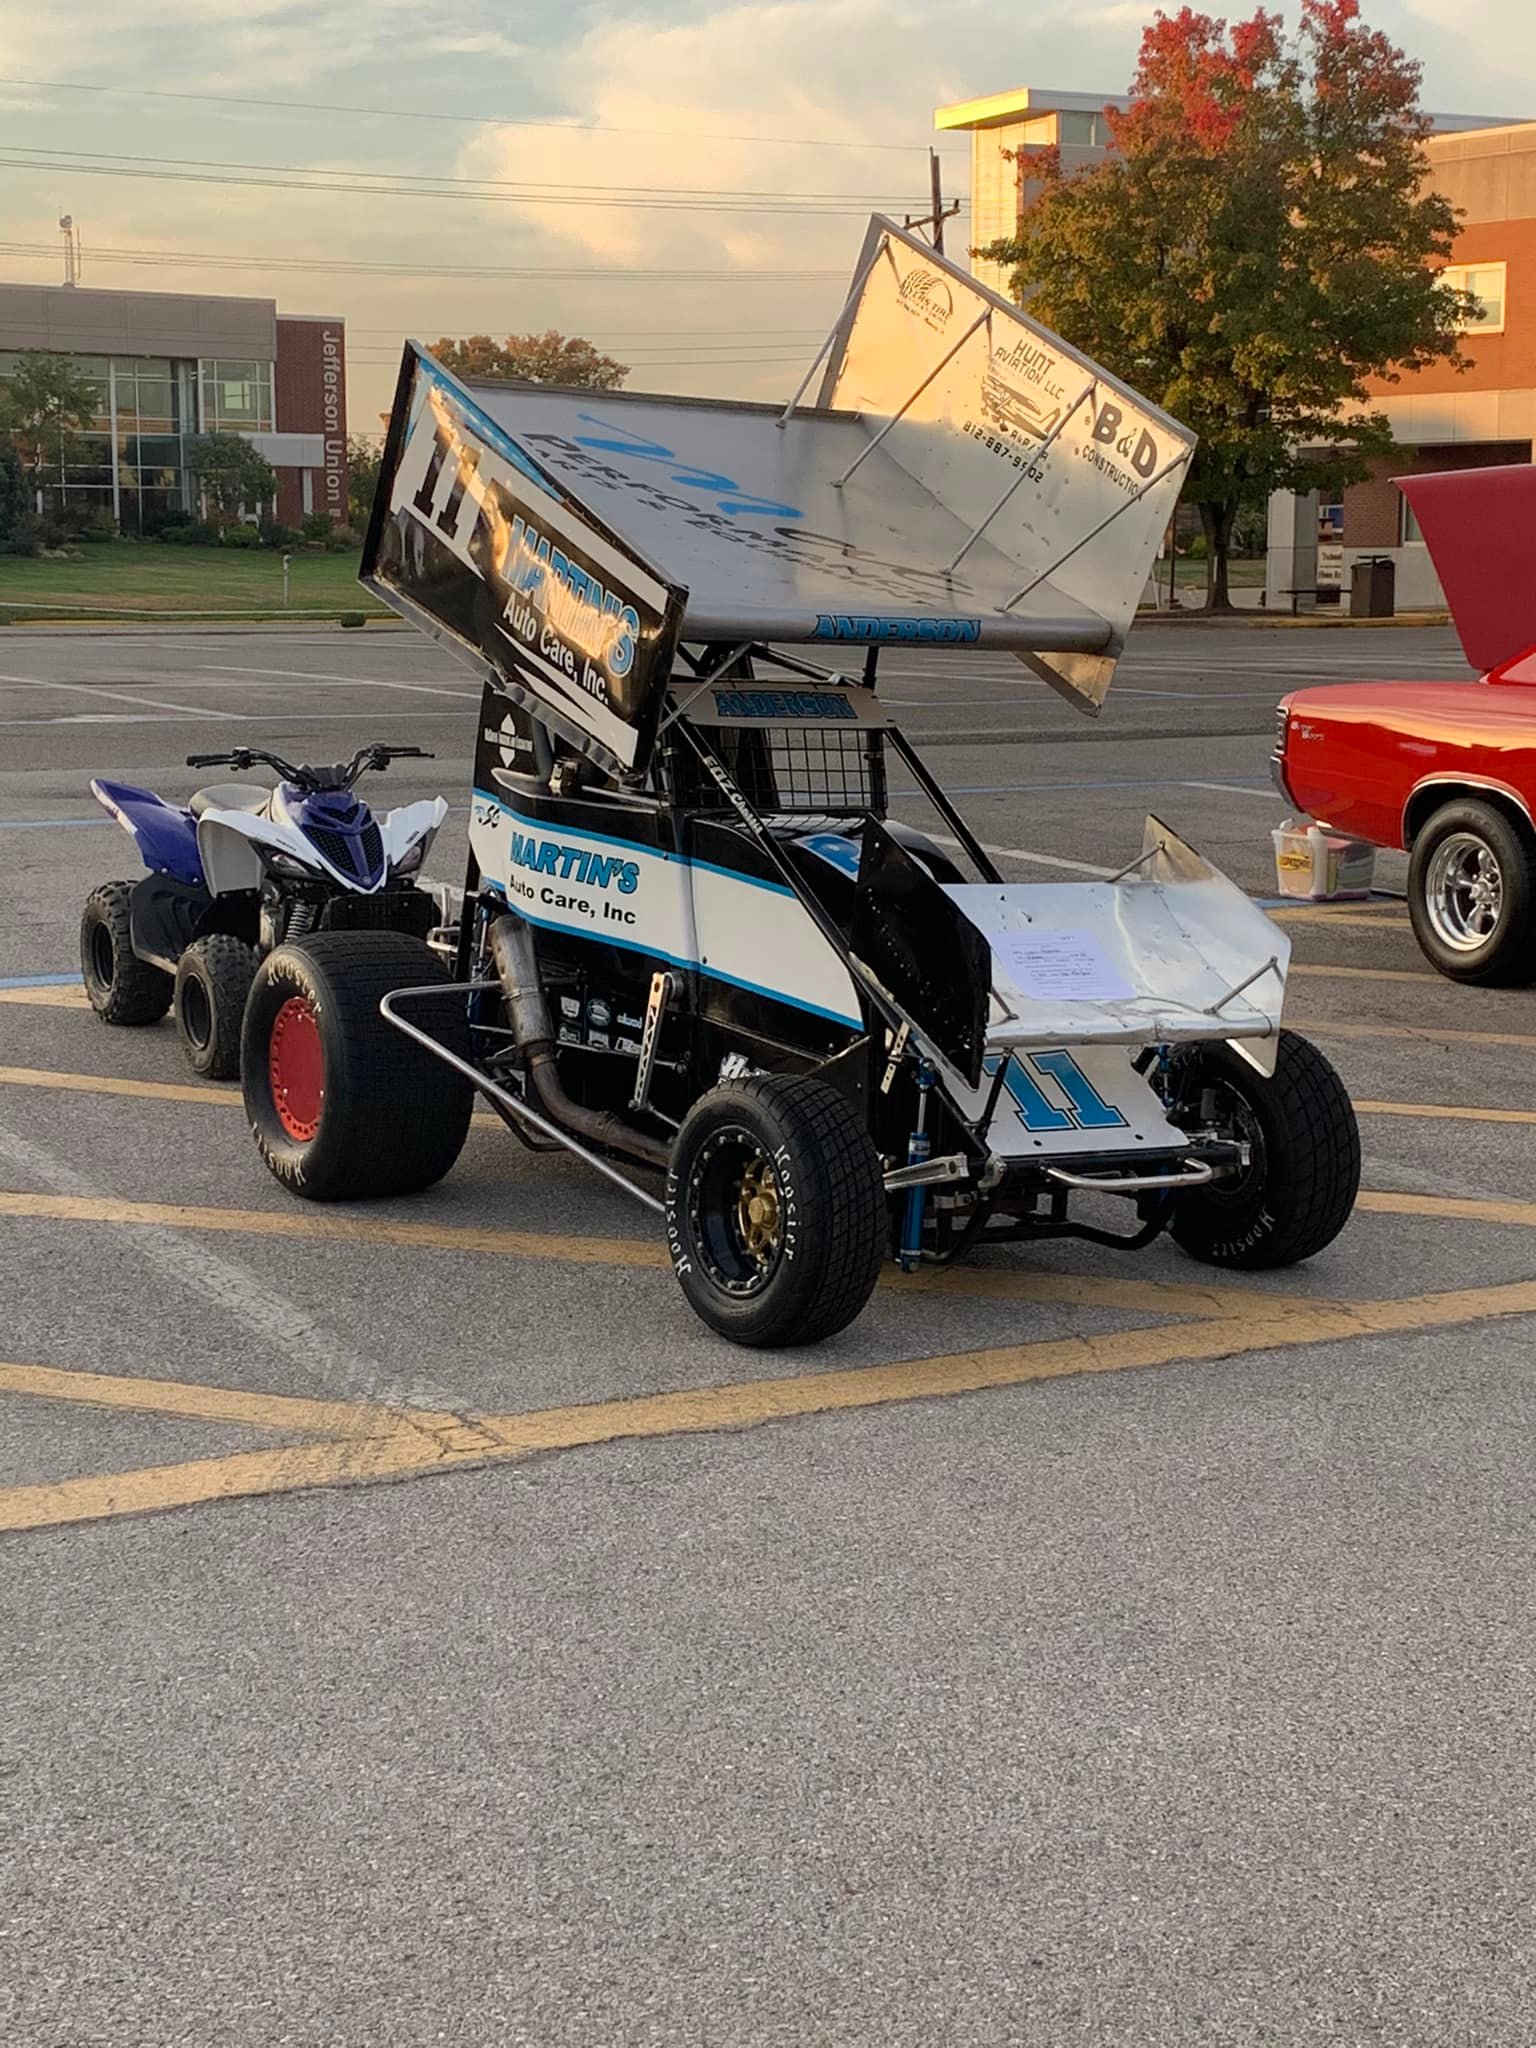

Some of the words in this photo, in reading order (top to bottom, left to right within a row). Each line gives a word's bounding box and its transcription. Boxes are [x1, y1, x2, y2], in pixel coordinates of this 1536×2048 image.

[322, 331, 341, 432] Jefferson
[994, 347, 1045, 387] AVIATION
[1044, 383, 1065, 400] LLC
[1013, 339, 1056, 375] HUNT
[325, 440, 344, 501] Union
[1082, 444, 1143, 497] CONSTRUCTIO
[1091, 401, 1158, 479] B&D
[412, 424, 482, 541] 11
[499, 513, 641, 678] MARTIN'S
[808, 615, 982, 643] ANDERSON
[503, 593, 537, 641] Auto
[540, 623, 578, 682] Care,
[582, 658, 609, 705] Inc.
[711, 689, 859, 719] ANDERSON
[509, 831, 641, 895] MARTIN'S
[510, 875, 535, 899] Auto
[540, 887, 596, 918] Care,
[603, 902, 637, 925] Inc
[982, 1048, 1131, 1133] 11
[665, 1167, 692, 1278] Hoosier
[774, 1144, 797, 1260] Hoosier
